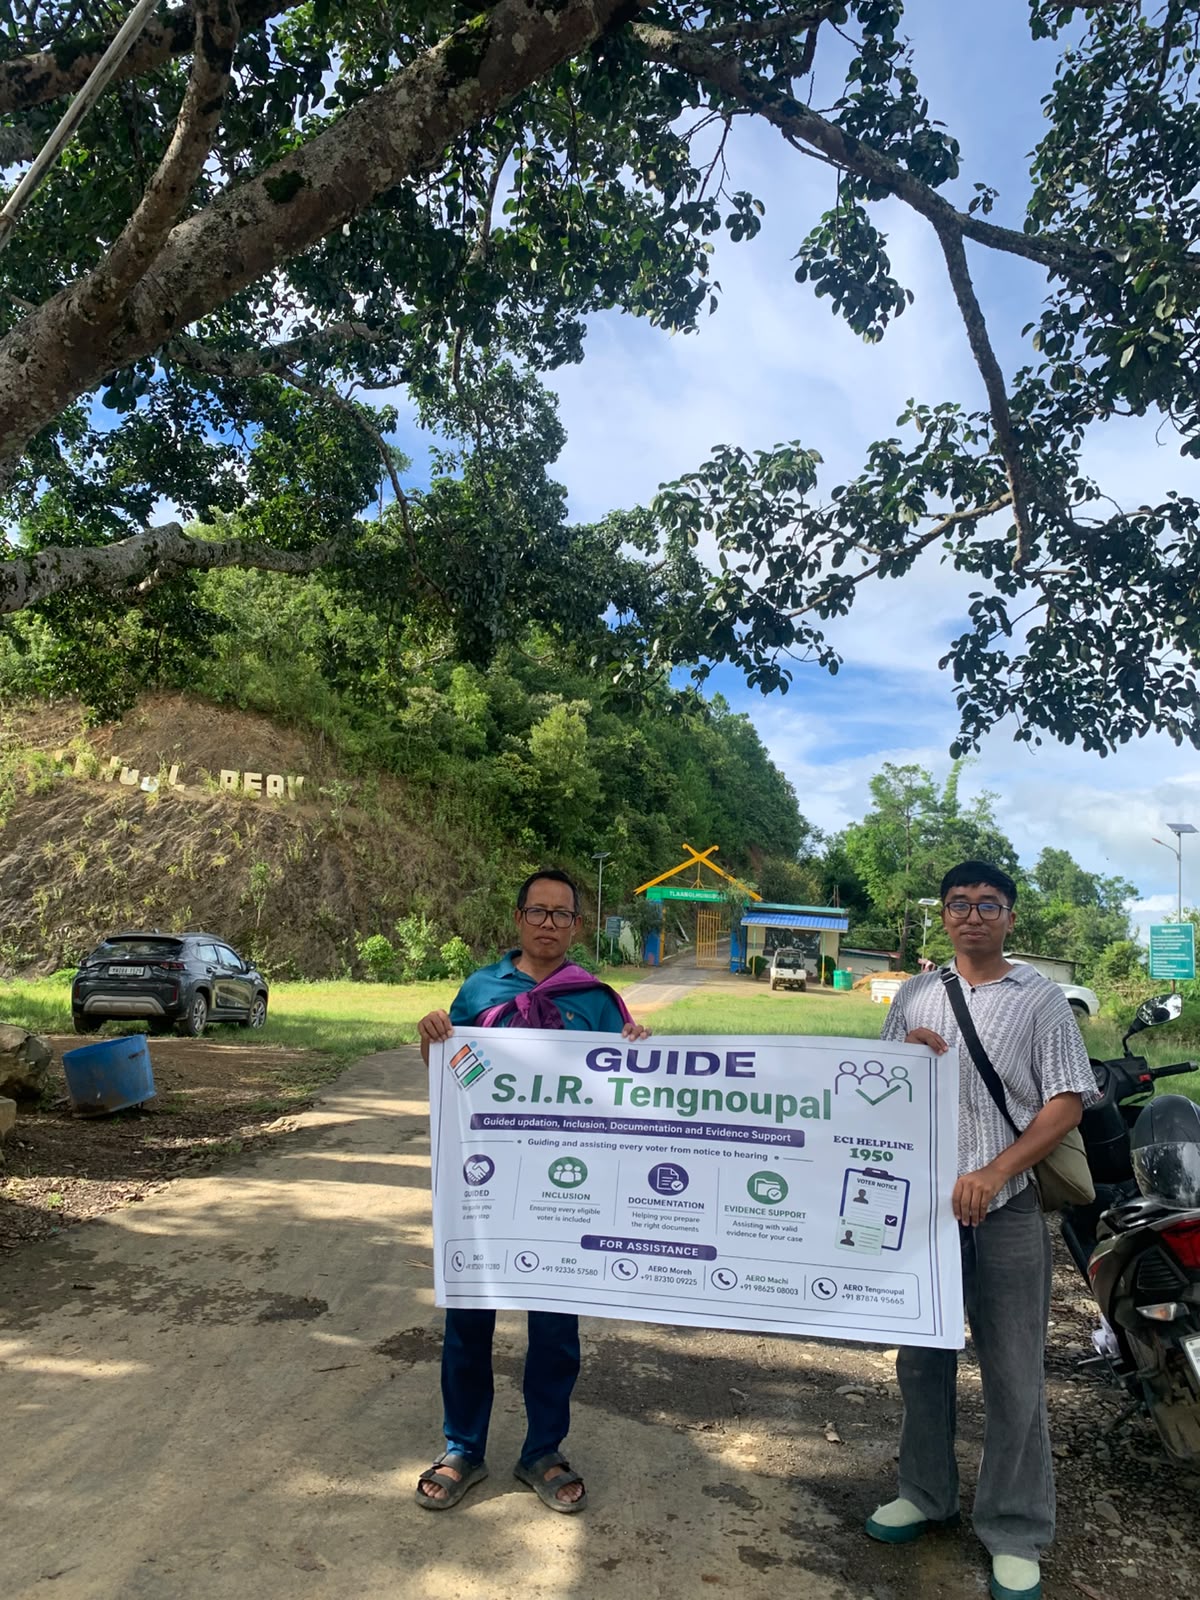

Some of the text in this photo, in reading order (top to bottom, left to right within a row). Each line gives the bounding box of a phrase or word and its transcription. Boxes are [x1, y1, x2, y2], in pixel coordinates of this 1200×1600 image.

[585, 1046, 757, 1079] GUIDE
[491, 1073, 594, 1105] S.I.R.
[607, 1077, 832, 1124] Tengnoupal
[483, 1117, 791, 1143] Guided updation, Inclusion, Documentation and Evidence Support
[528, 1138, 768, 1162] Guiding and assisting every voter from notice to hearing
[833, 1136, 914, 1151] ECI HELPLINE
[849, 1147, 894, 1162] 1950
[856, 1177, 898, 1191] VOTER NOTICE
[541, 1191, 591, 1201] INCLUSION
[628, 1196, 705, 1210] DOCUMENTATION
[529, 1204, 601, 1216] Ensuring every eligible
[724, 1204, 807, 1220] EVIDENCE SUPPORT
[537, 1214, 554, 1222] voter
[562, 1215, 591, 1224] included
[632, 1211, 700, 1225] Helping you prepare
[631, 1221, 699, 1233] the right documents
[732, 1219, 798, 1233] Assisting with valid
[726, 1229, 803, 1243] evidence for your case
[599, 1239, 699, 1257] FOR ASSISTANCE
[561, 1257, 577, 1265] ERO
[541, 1265, 599, 1276] +91 92336 57580
[648, 1265, 692, 1275] AERO Moreh
[654, 1275, 675, 1284] 87310
[675, 1277, 698, 1286] 09225
[745, 1274, 789, 1284] AERO Machi
[753, 1284, 775, 1293] 98625
[776, 1286, 799, 1295] 08003
[843, 1284, 905, 1296] AERO Tengnoupal
[841, 1293, 905, 1305] +91 87874 95665
